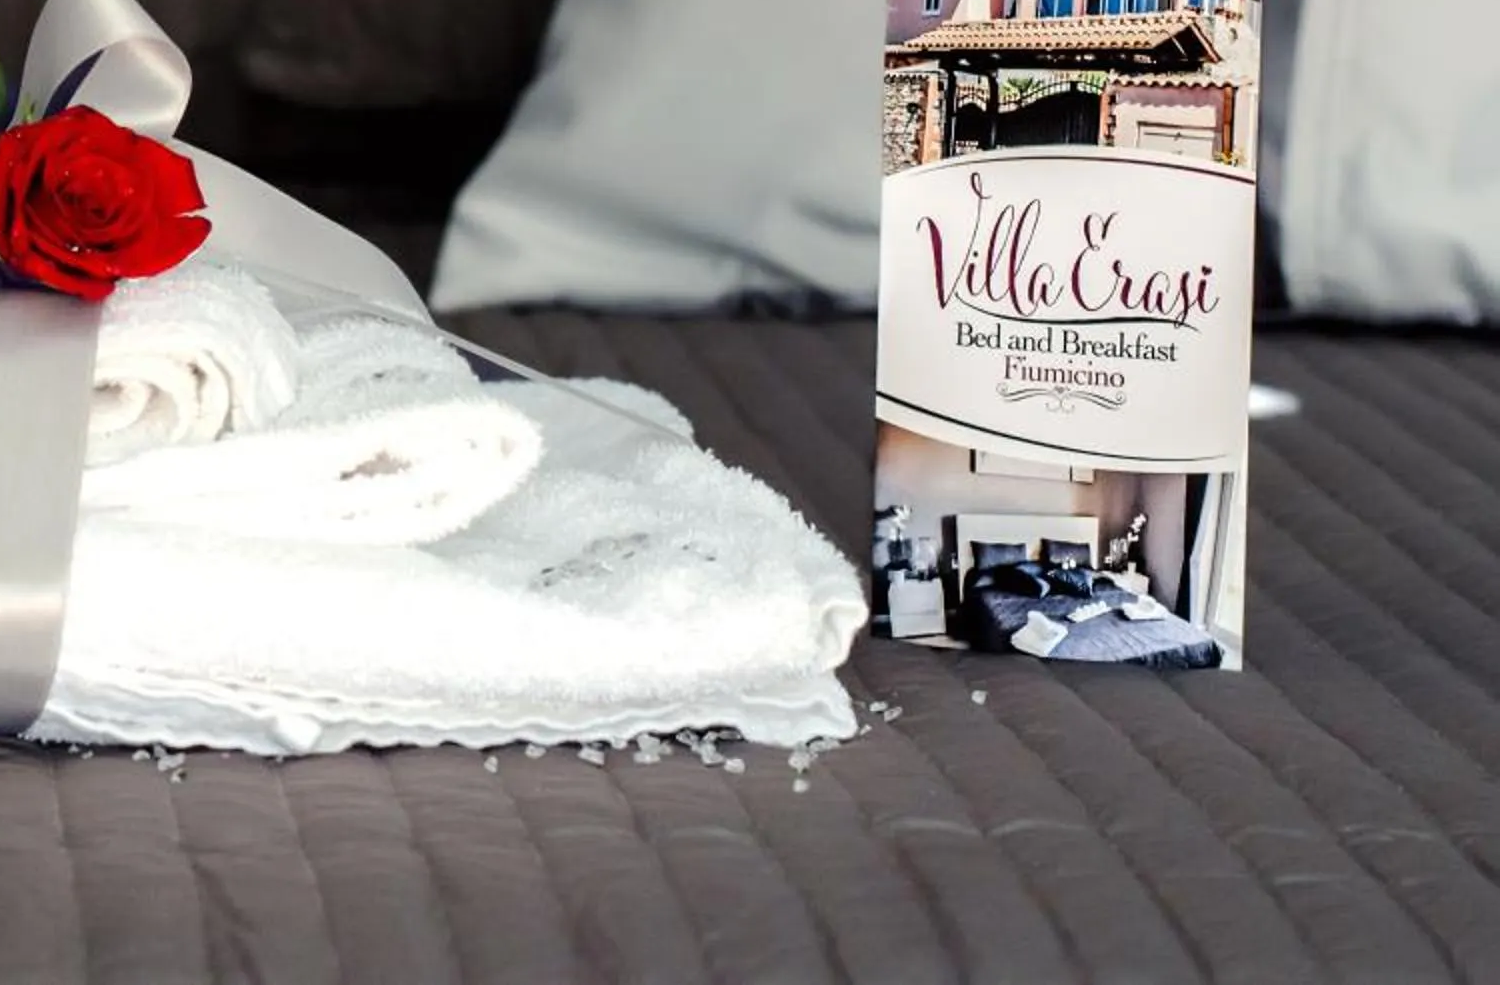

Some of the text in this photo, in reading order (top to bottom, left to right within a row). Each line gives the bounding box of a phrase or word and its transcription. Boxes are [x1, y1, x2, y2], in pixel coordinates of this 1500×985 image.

[916, 172, 1221, 328] Villa Erasi
[955, 322, 1178, 362] Bed and Breakfast
[1003, 355, 1126, 389] Fiumicino
